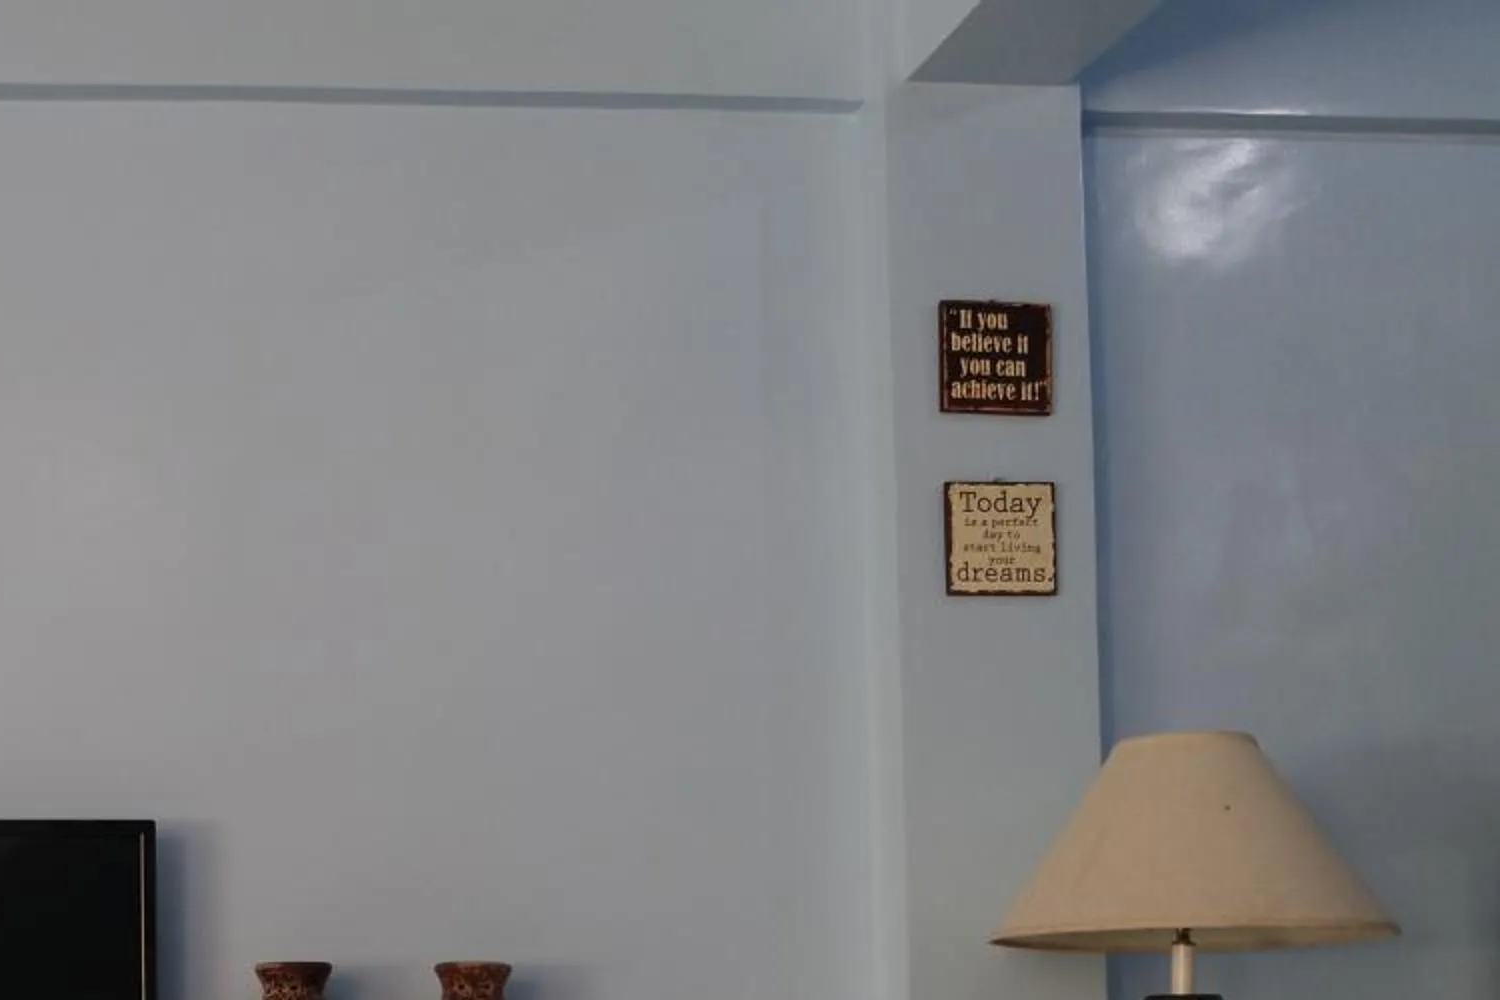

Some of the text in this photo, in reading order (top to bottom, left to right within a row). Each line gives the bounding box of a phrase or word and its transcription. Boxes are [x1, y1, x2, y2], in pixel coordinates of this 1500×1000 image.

[977, 312, 1008, 331] you
[951, 332, 1028, 354] believe it
[960, 356, 1026, 378] you can
[951, 379, 1015, 401] achieve
[959, 490, 1042, 519] Today
[957, 561, 1053, 582] dreams.
